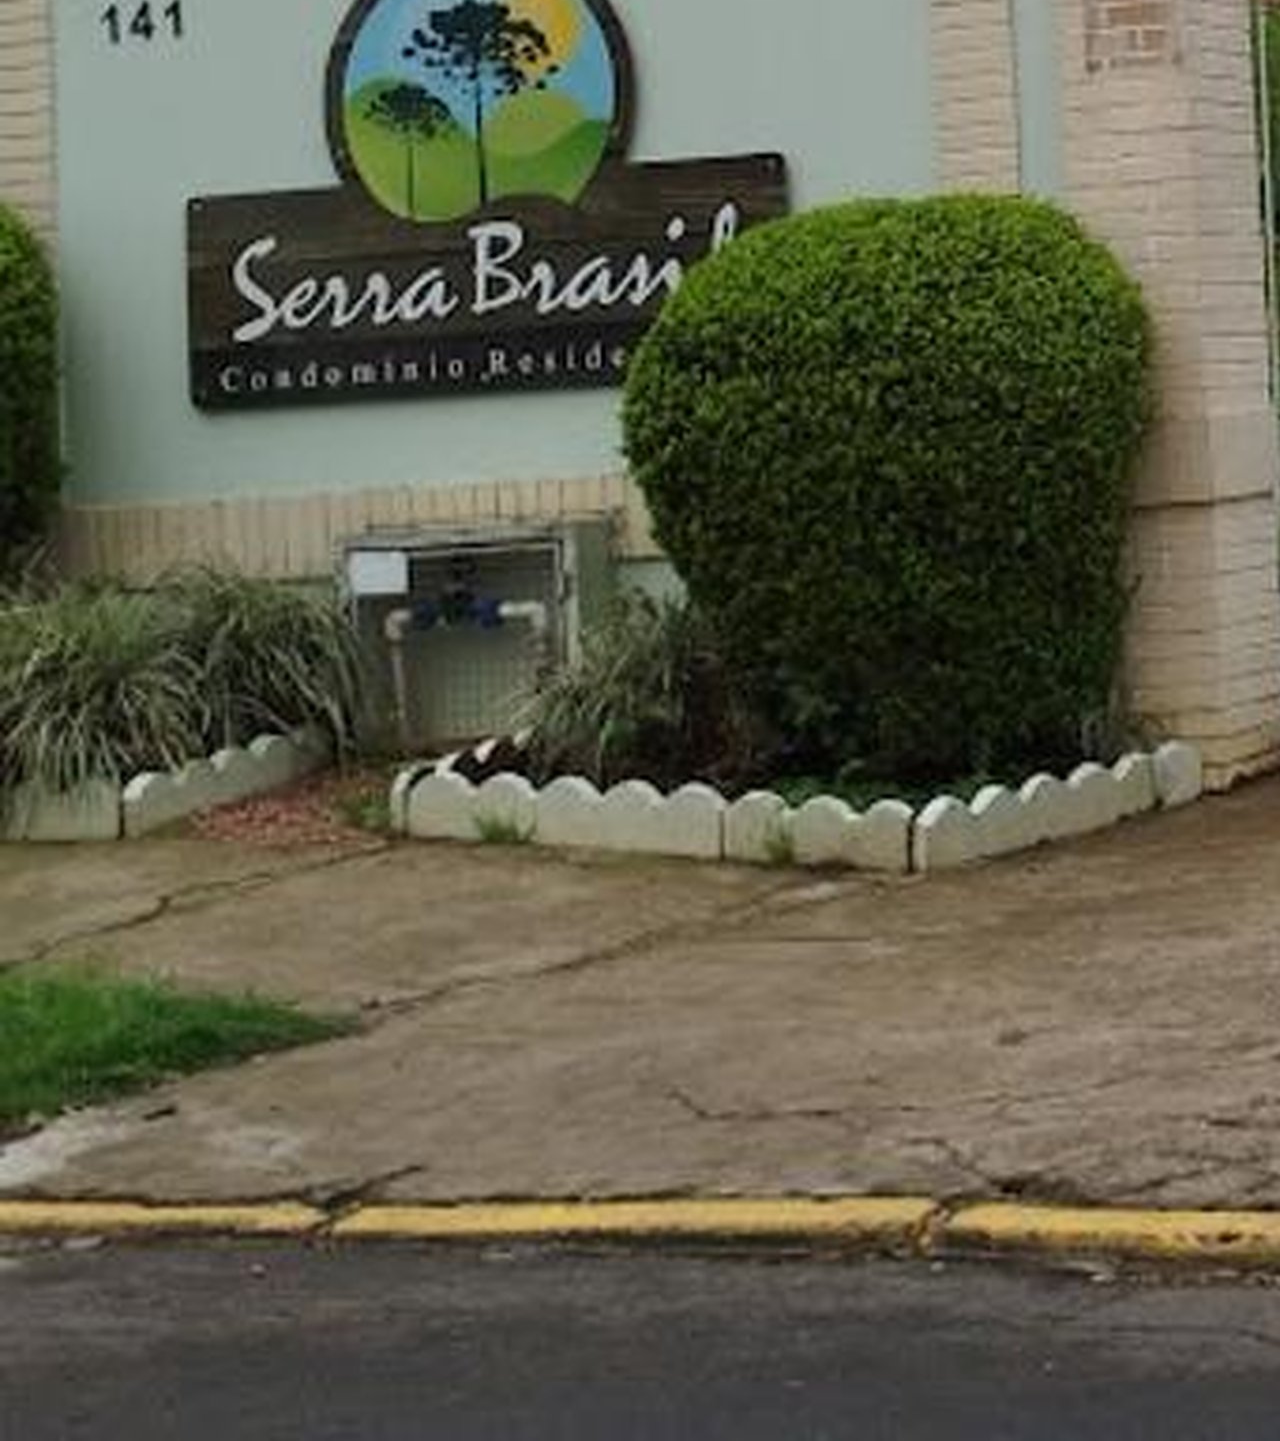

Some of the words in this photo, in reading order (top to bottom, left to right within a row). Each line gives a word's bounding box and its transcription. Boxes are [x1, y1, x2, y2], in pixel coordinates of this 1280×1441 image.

[100, 0, 182, 45] 141
[232, 235, 459, 343] Serra
[488, 340, 627, 376] Reside
